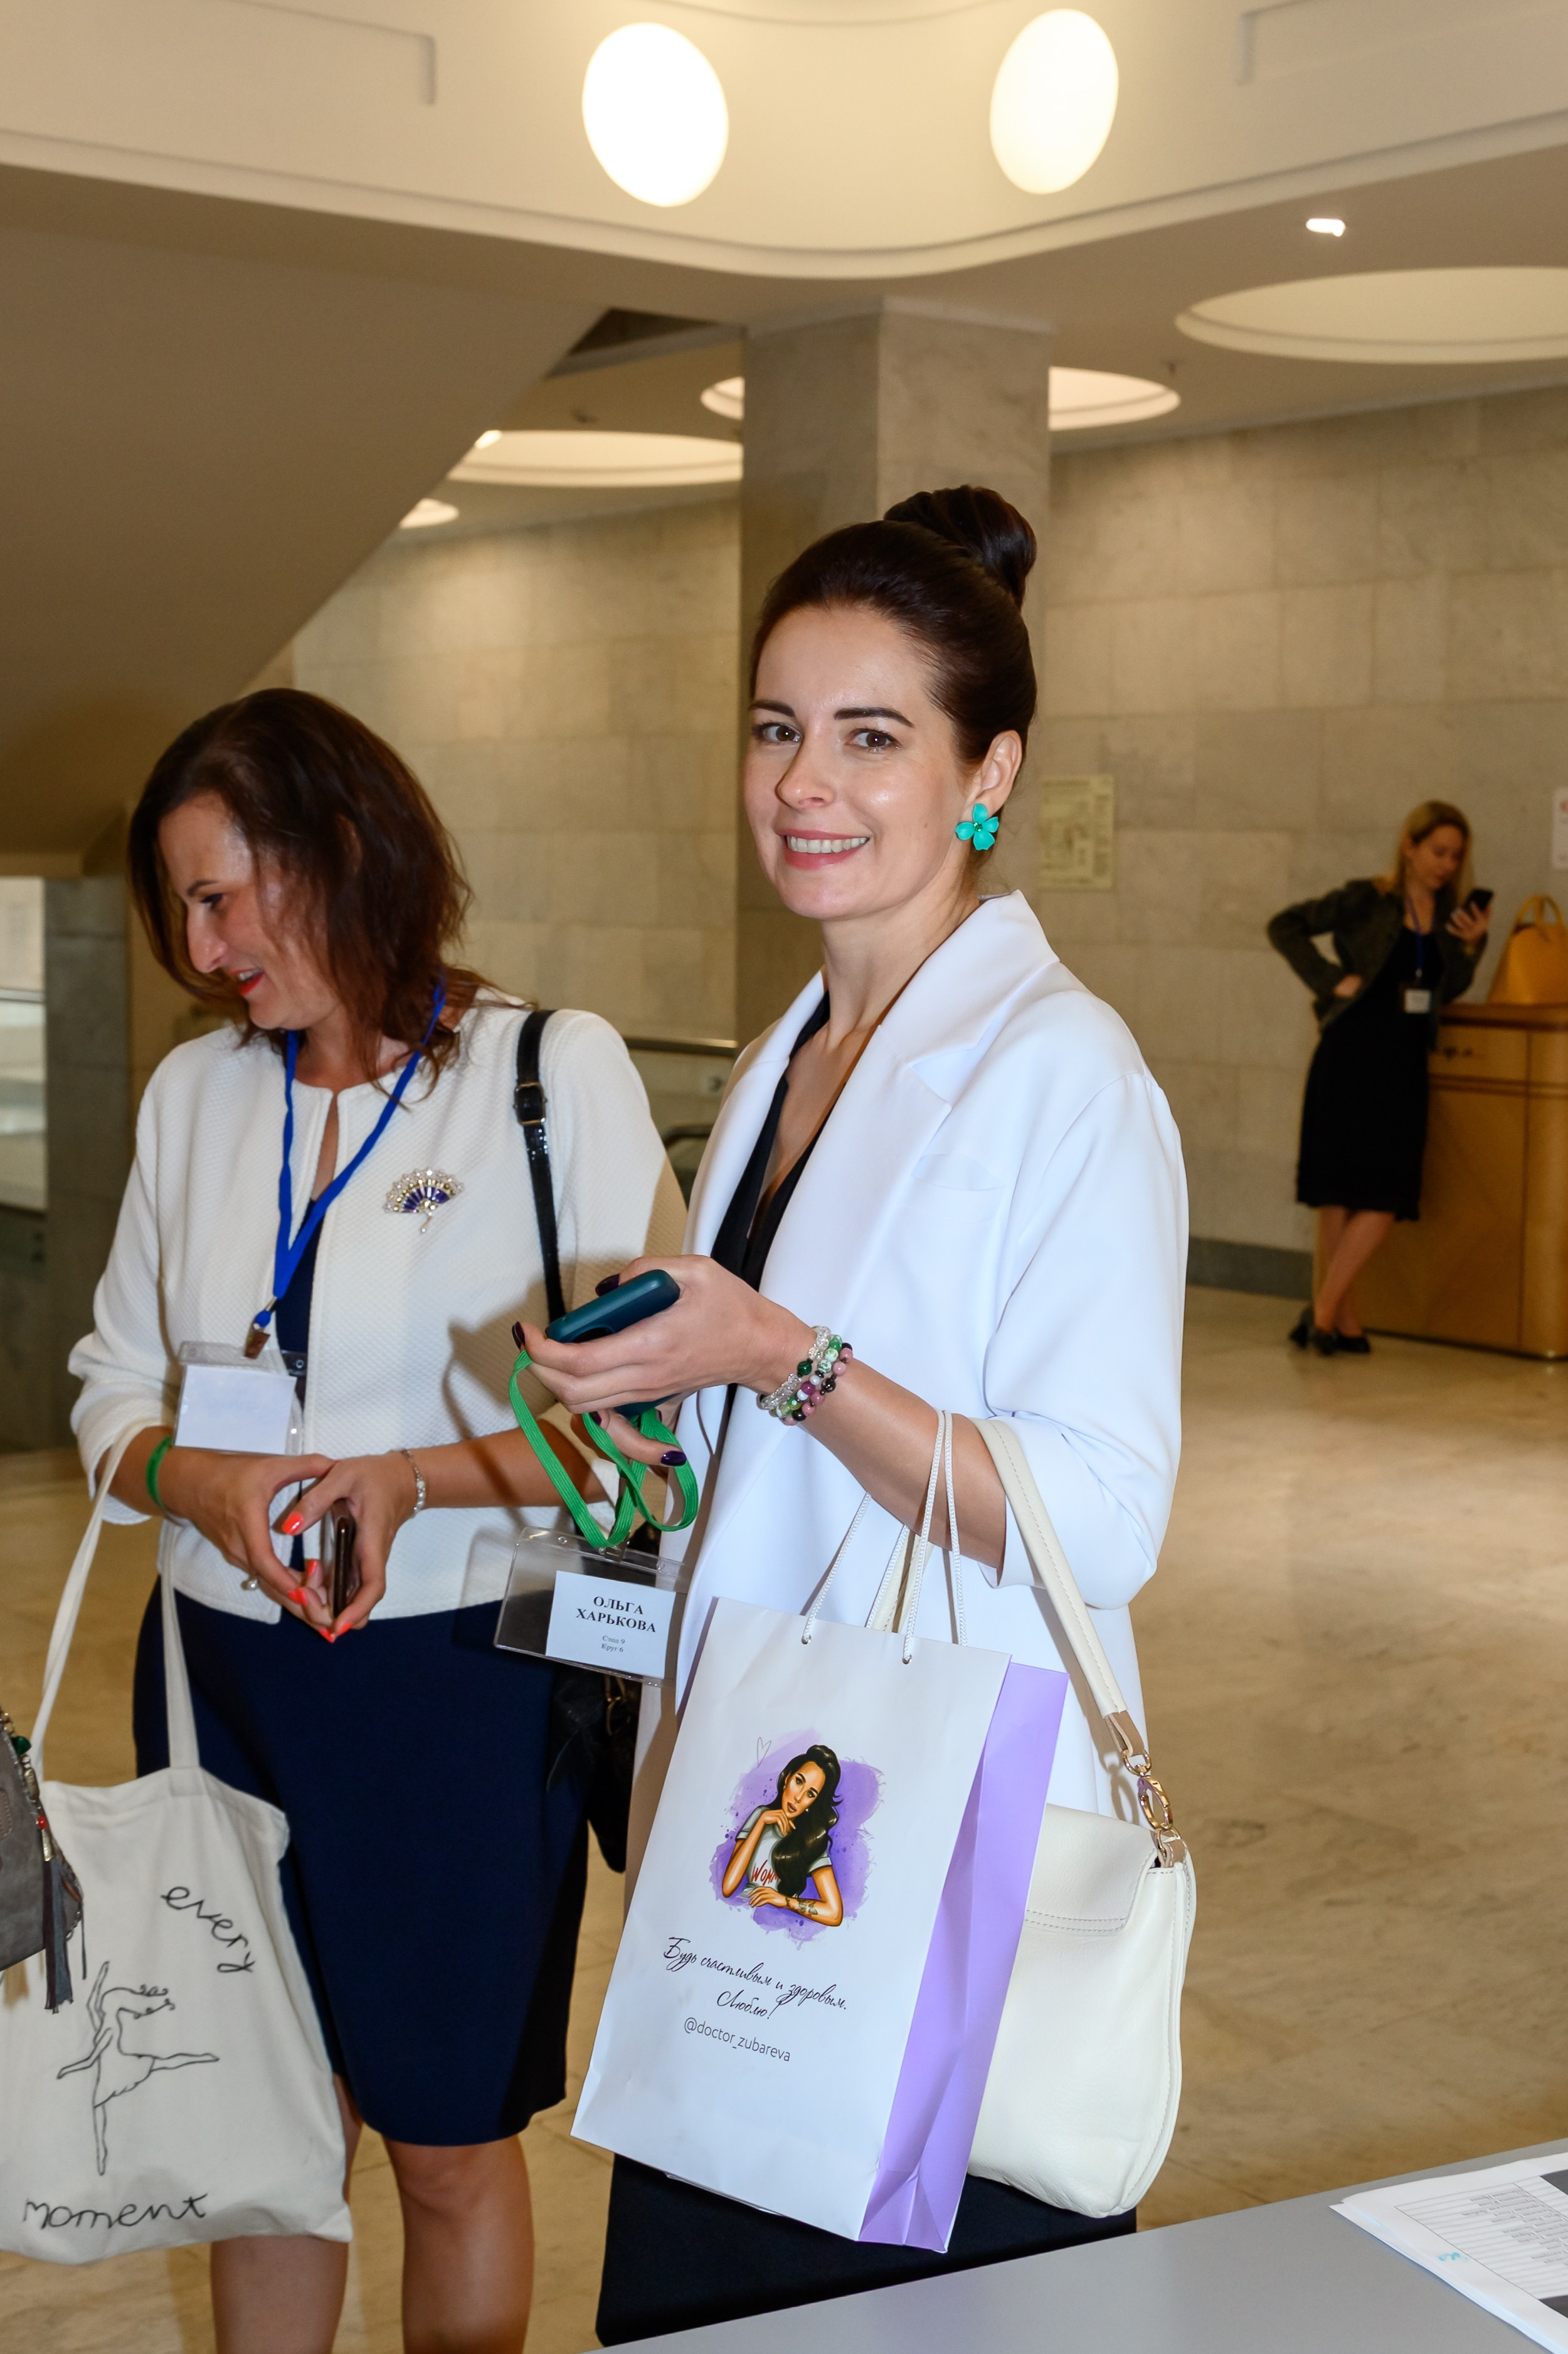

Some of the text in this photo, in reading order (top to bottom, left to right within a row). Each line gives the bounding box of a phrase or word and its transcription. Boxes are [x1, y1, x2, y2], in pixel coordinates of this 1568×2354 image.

[576, 1608, 656, 1633] ХАРЬКОВА
[593, 1596, 644, 1614] ОЛЬГА
[601, 1643, 617, 1652] Круг
[161, 1885, 256, 1973] every
[664, 1937, 846, 2010] Будь счастливым и здоровым.
[717, 1989, 781, 2020] Люблю!
[684, 2017, 791, 2062] @doctor_zubareva
[23, 2193, 208, 2230] moment
